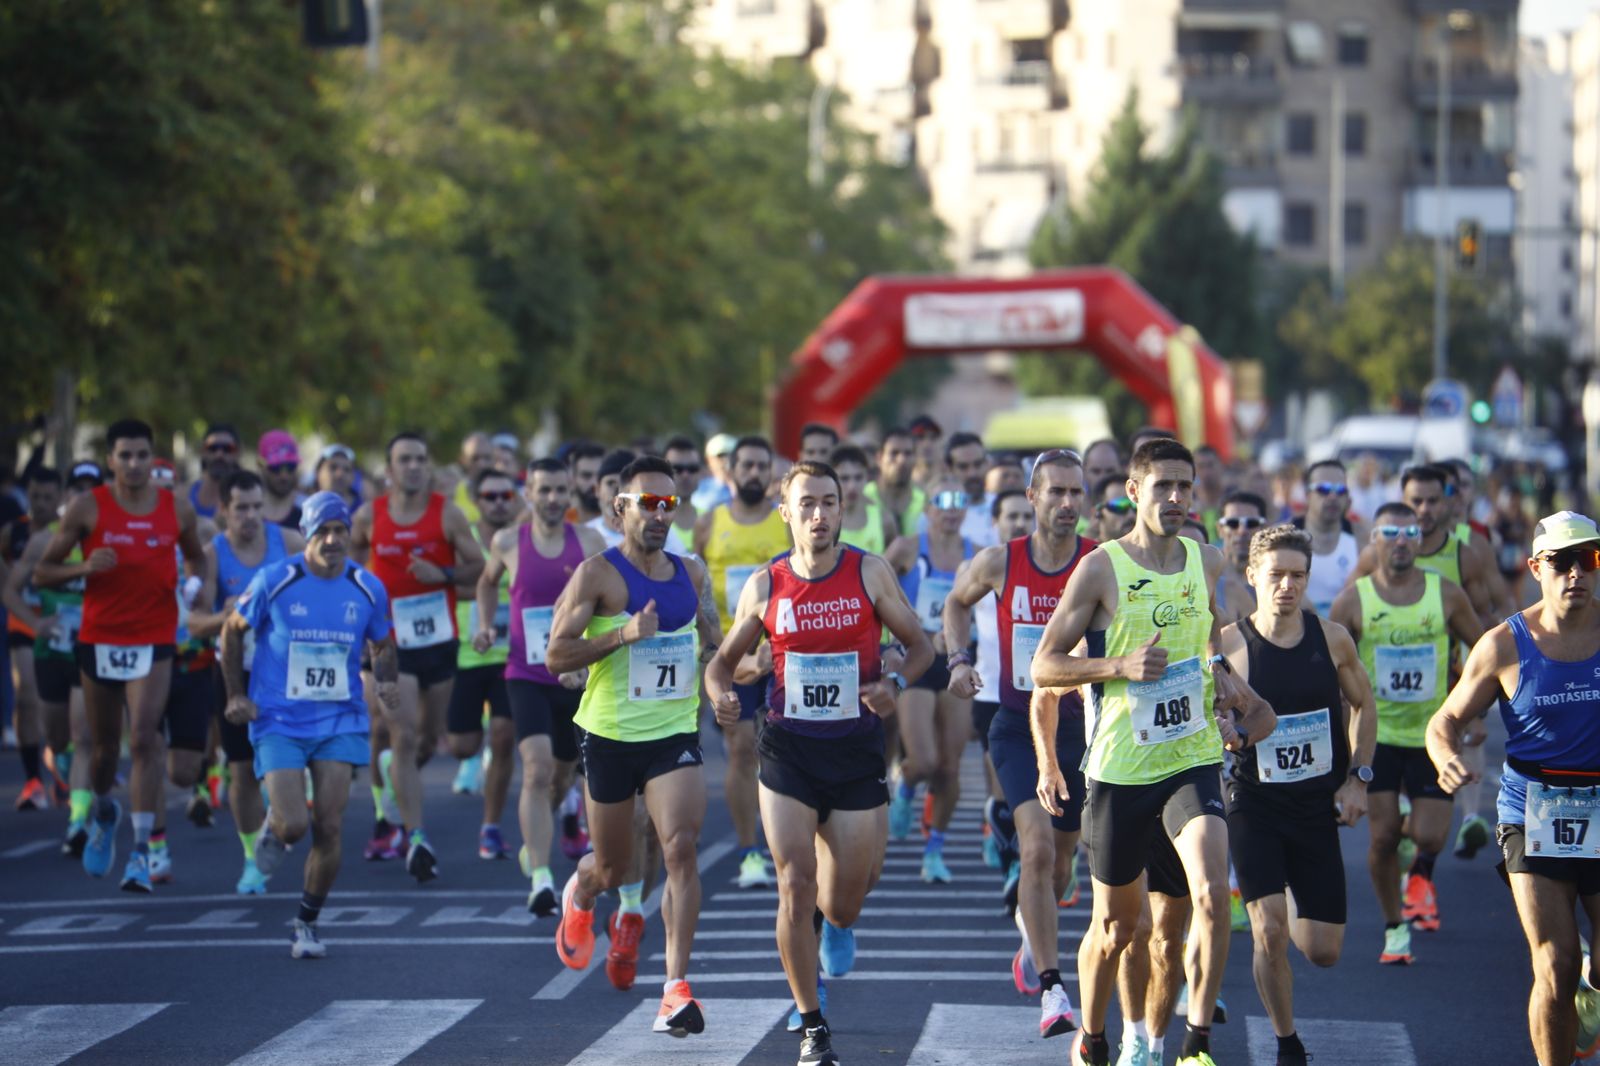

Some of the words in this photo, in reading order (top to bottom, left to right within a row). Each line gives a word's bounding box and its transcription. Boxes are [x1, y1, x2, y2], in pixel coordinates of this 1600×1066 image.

[306, 667, 336, 688] 579
[656, 664, 676, 687] 71
[1390, 671, 1423, 691] 342
[802, 684, 841, 708] 502
[1153, 695, 1191, 729] 498
[1275, 743, 1315, 770] 524
[1551, 818, 1590, 846] 157
